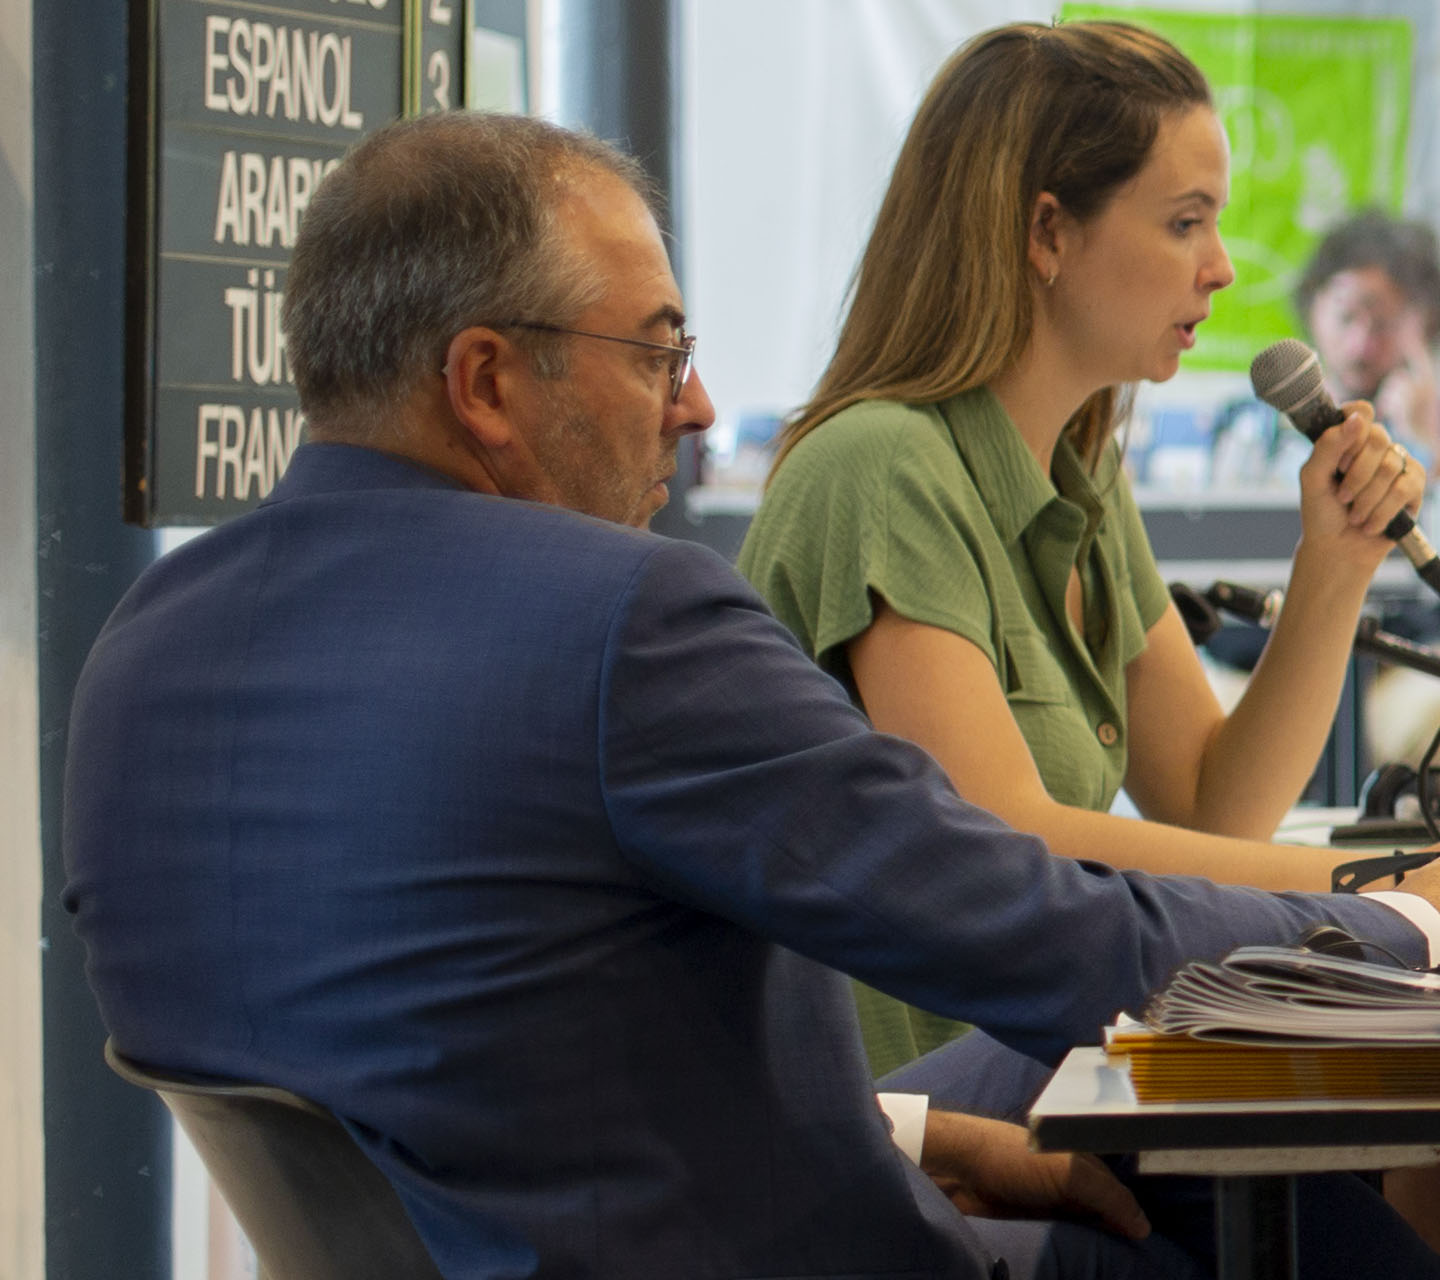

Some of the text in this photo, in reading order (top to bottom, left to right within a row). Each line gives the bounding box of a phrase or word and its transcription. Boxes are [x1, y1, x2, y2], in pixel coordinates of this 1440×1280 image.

[204, 15, 364, 131] ESPANOL
[427, 50, 451, 112] 3
[214, 151, 341, 249] ARAB
